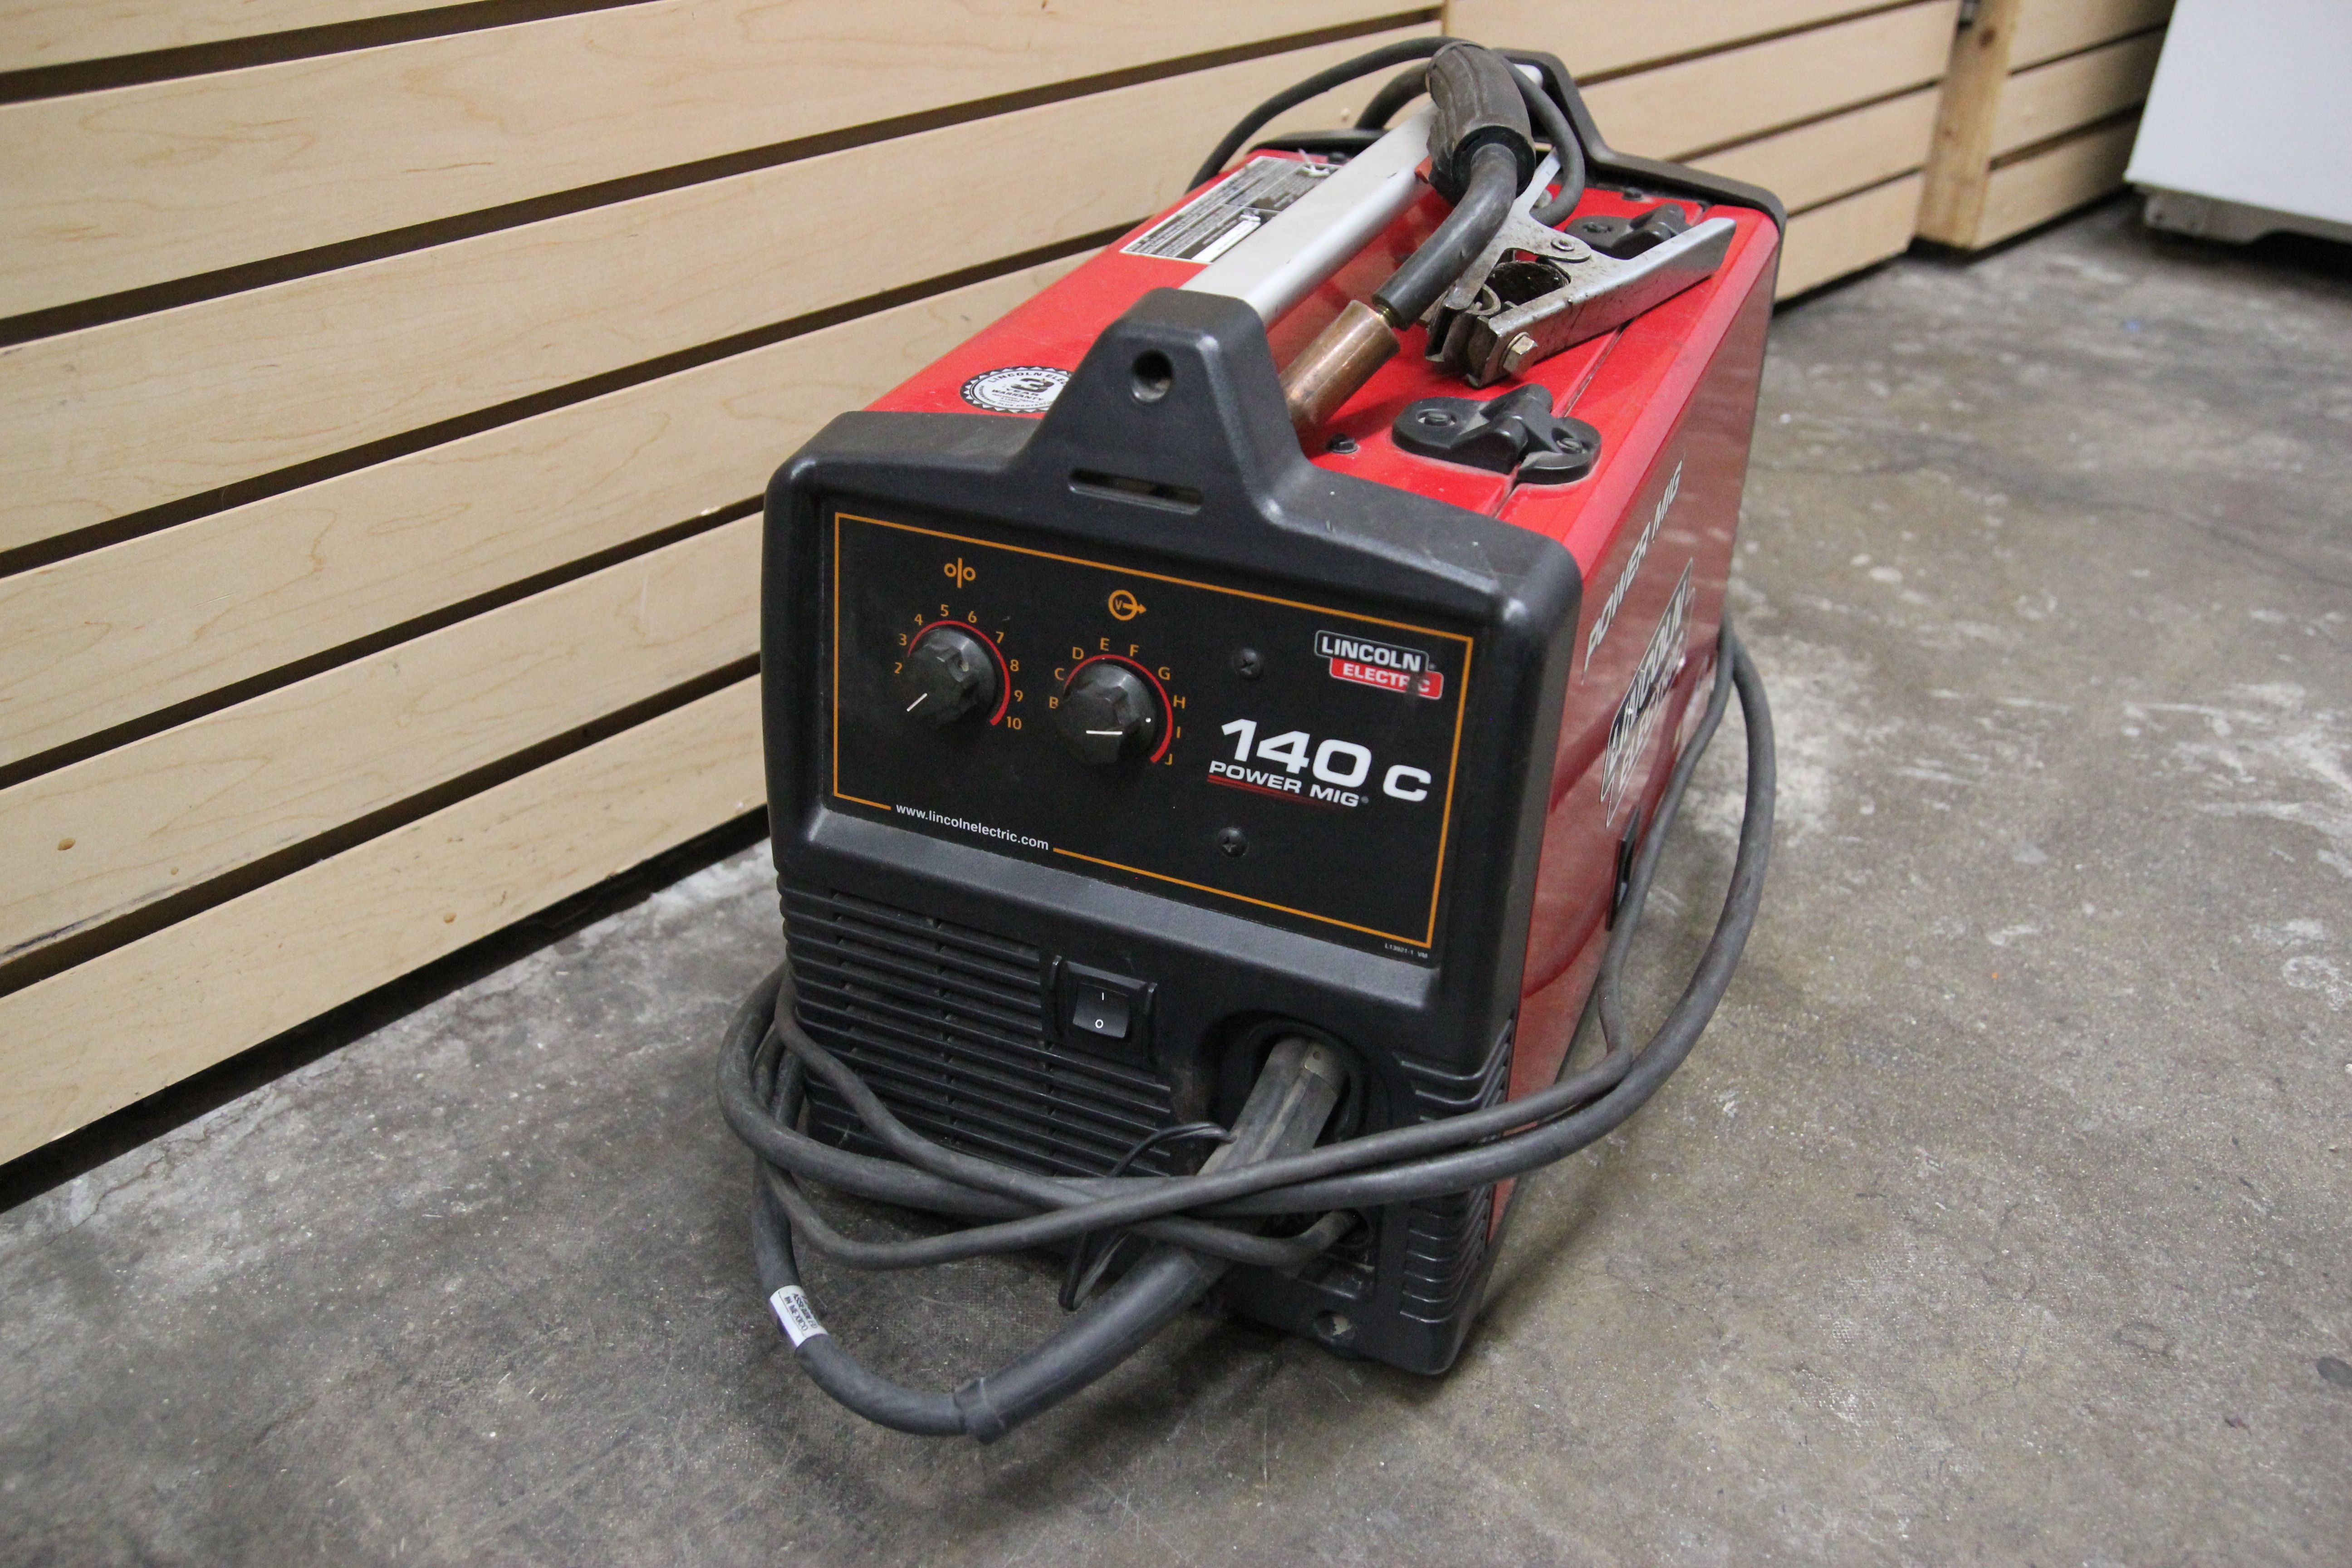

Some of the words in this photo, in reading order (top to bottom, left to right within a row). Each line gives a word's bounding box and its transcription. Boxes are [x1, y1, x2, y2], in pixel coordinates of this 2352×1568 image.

[988, 372, 1042, 383] LINCOLN
[1045, 374, 1067, 386] ELEC
[1011, 378, 1054, 393] 3
[992, 389, 1044, 401] WARRANTY
[1006, 388, 1039, 396] YEAR
[1582, 521, 1650, 681] POWER
[1651, 460, 1682, 540] MIG
[940, 604, 949, 617] 5
[968, 611, 977, 623] 6
[914, 613, 923, 626] 4
[899, 633, 907, 646] 3
[995, 631, 1004, 644] 7
[1100, 637, 1110, 651] E
[1072, 647, 1084, 660] D
[1130, 644, 1139, 657] F
[1322, 636, 1421, 672] LINCOLN
[894, 662, 902, 674] 2
[1010, 659, 1019, 671] 8
[1054, 667, 1064, 680] C
[1158, 666, 1171, 680] G
[1343, 662, 1430, 692] ELECTRC
[1608, 579, 1687, 777] LINCOLN
[1014, 690, 1023, 702] 9
[1049, 696, 1058, 709] B
[1173, 695, 1186, 709] H
[1007, 716, 1022, 730] 10
[1165, 754, 1173, 765] J
[1221, 719, 1372, 788] 140
[1383, 764, 1431, 802] C
[1209, 760, 1302, 794] POWER
[896, 804, 1049, 850] www.lincolnelectric.com
[789, 1304, 808, 1331] MEXICO
